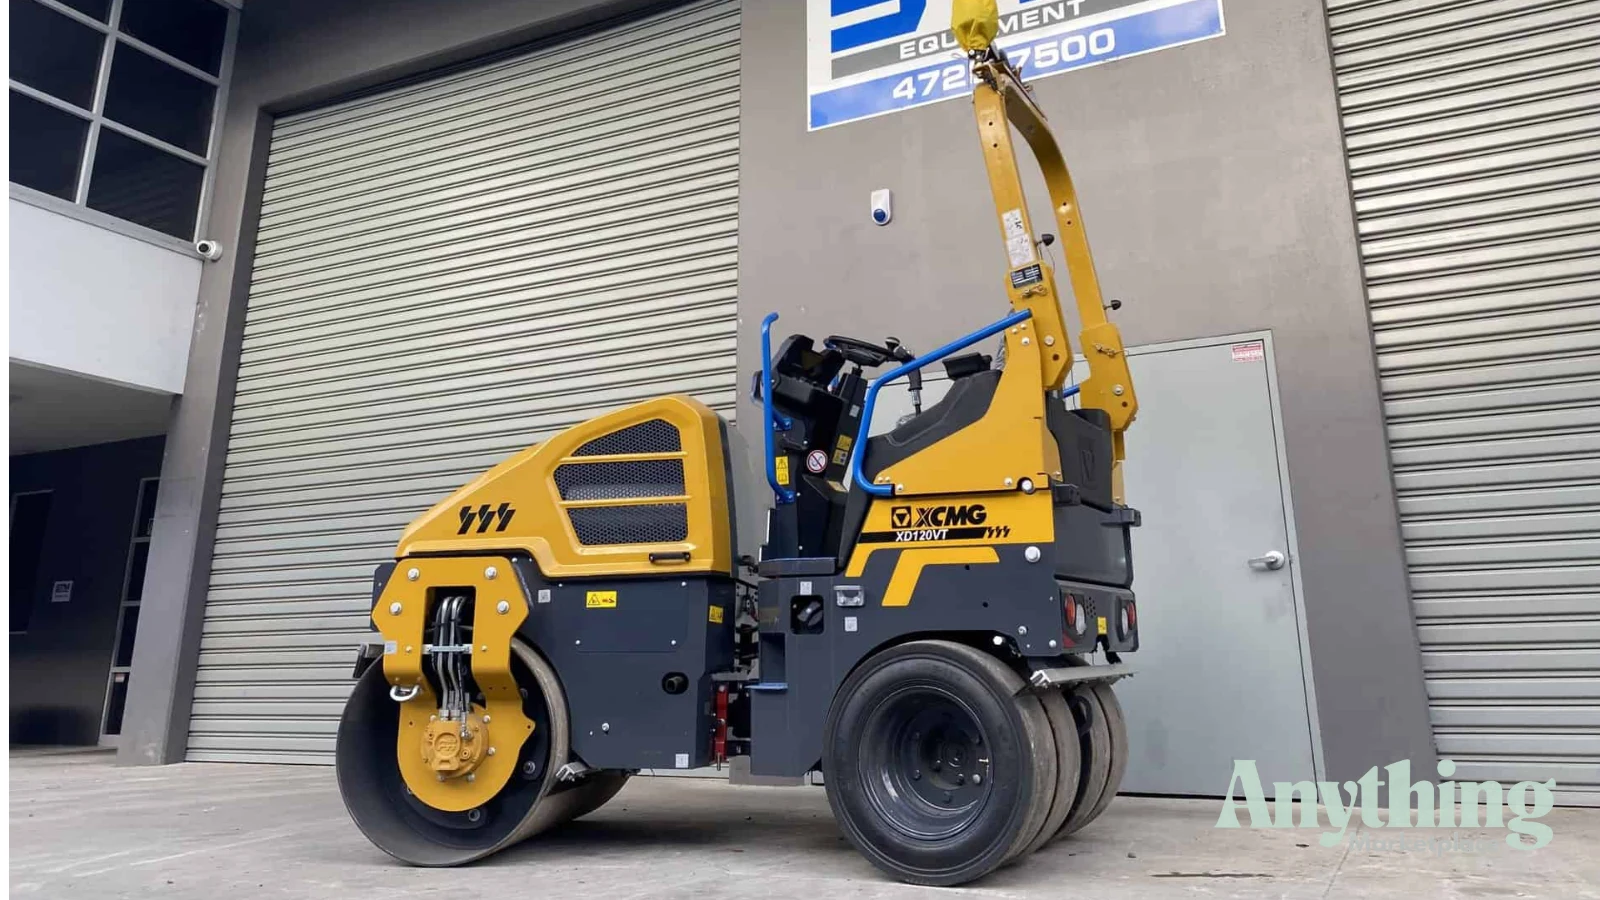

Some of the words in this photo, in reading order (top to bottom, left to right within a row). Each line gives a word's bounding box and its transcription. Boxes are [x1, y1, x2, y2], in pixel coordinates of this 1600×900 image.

[900, 0, 1085, 59] EQUMENT
[892, 63, 992, 99] 472
[1006, 28, 1115, 71] 7500
[896, 529, 949, 541] XD120VT
[914, 504, 987, 527] XCMG
